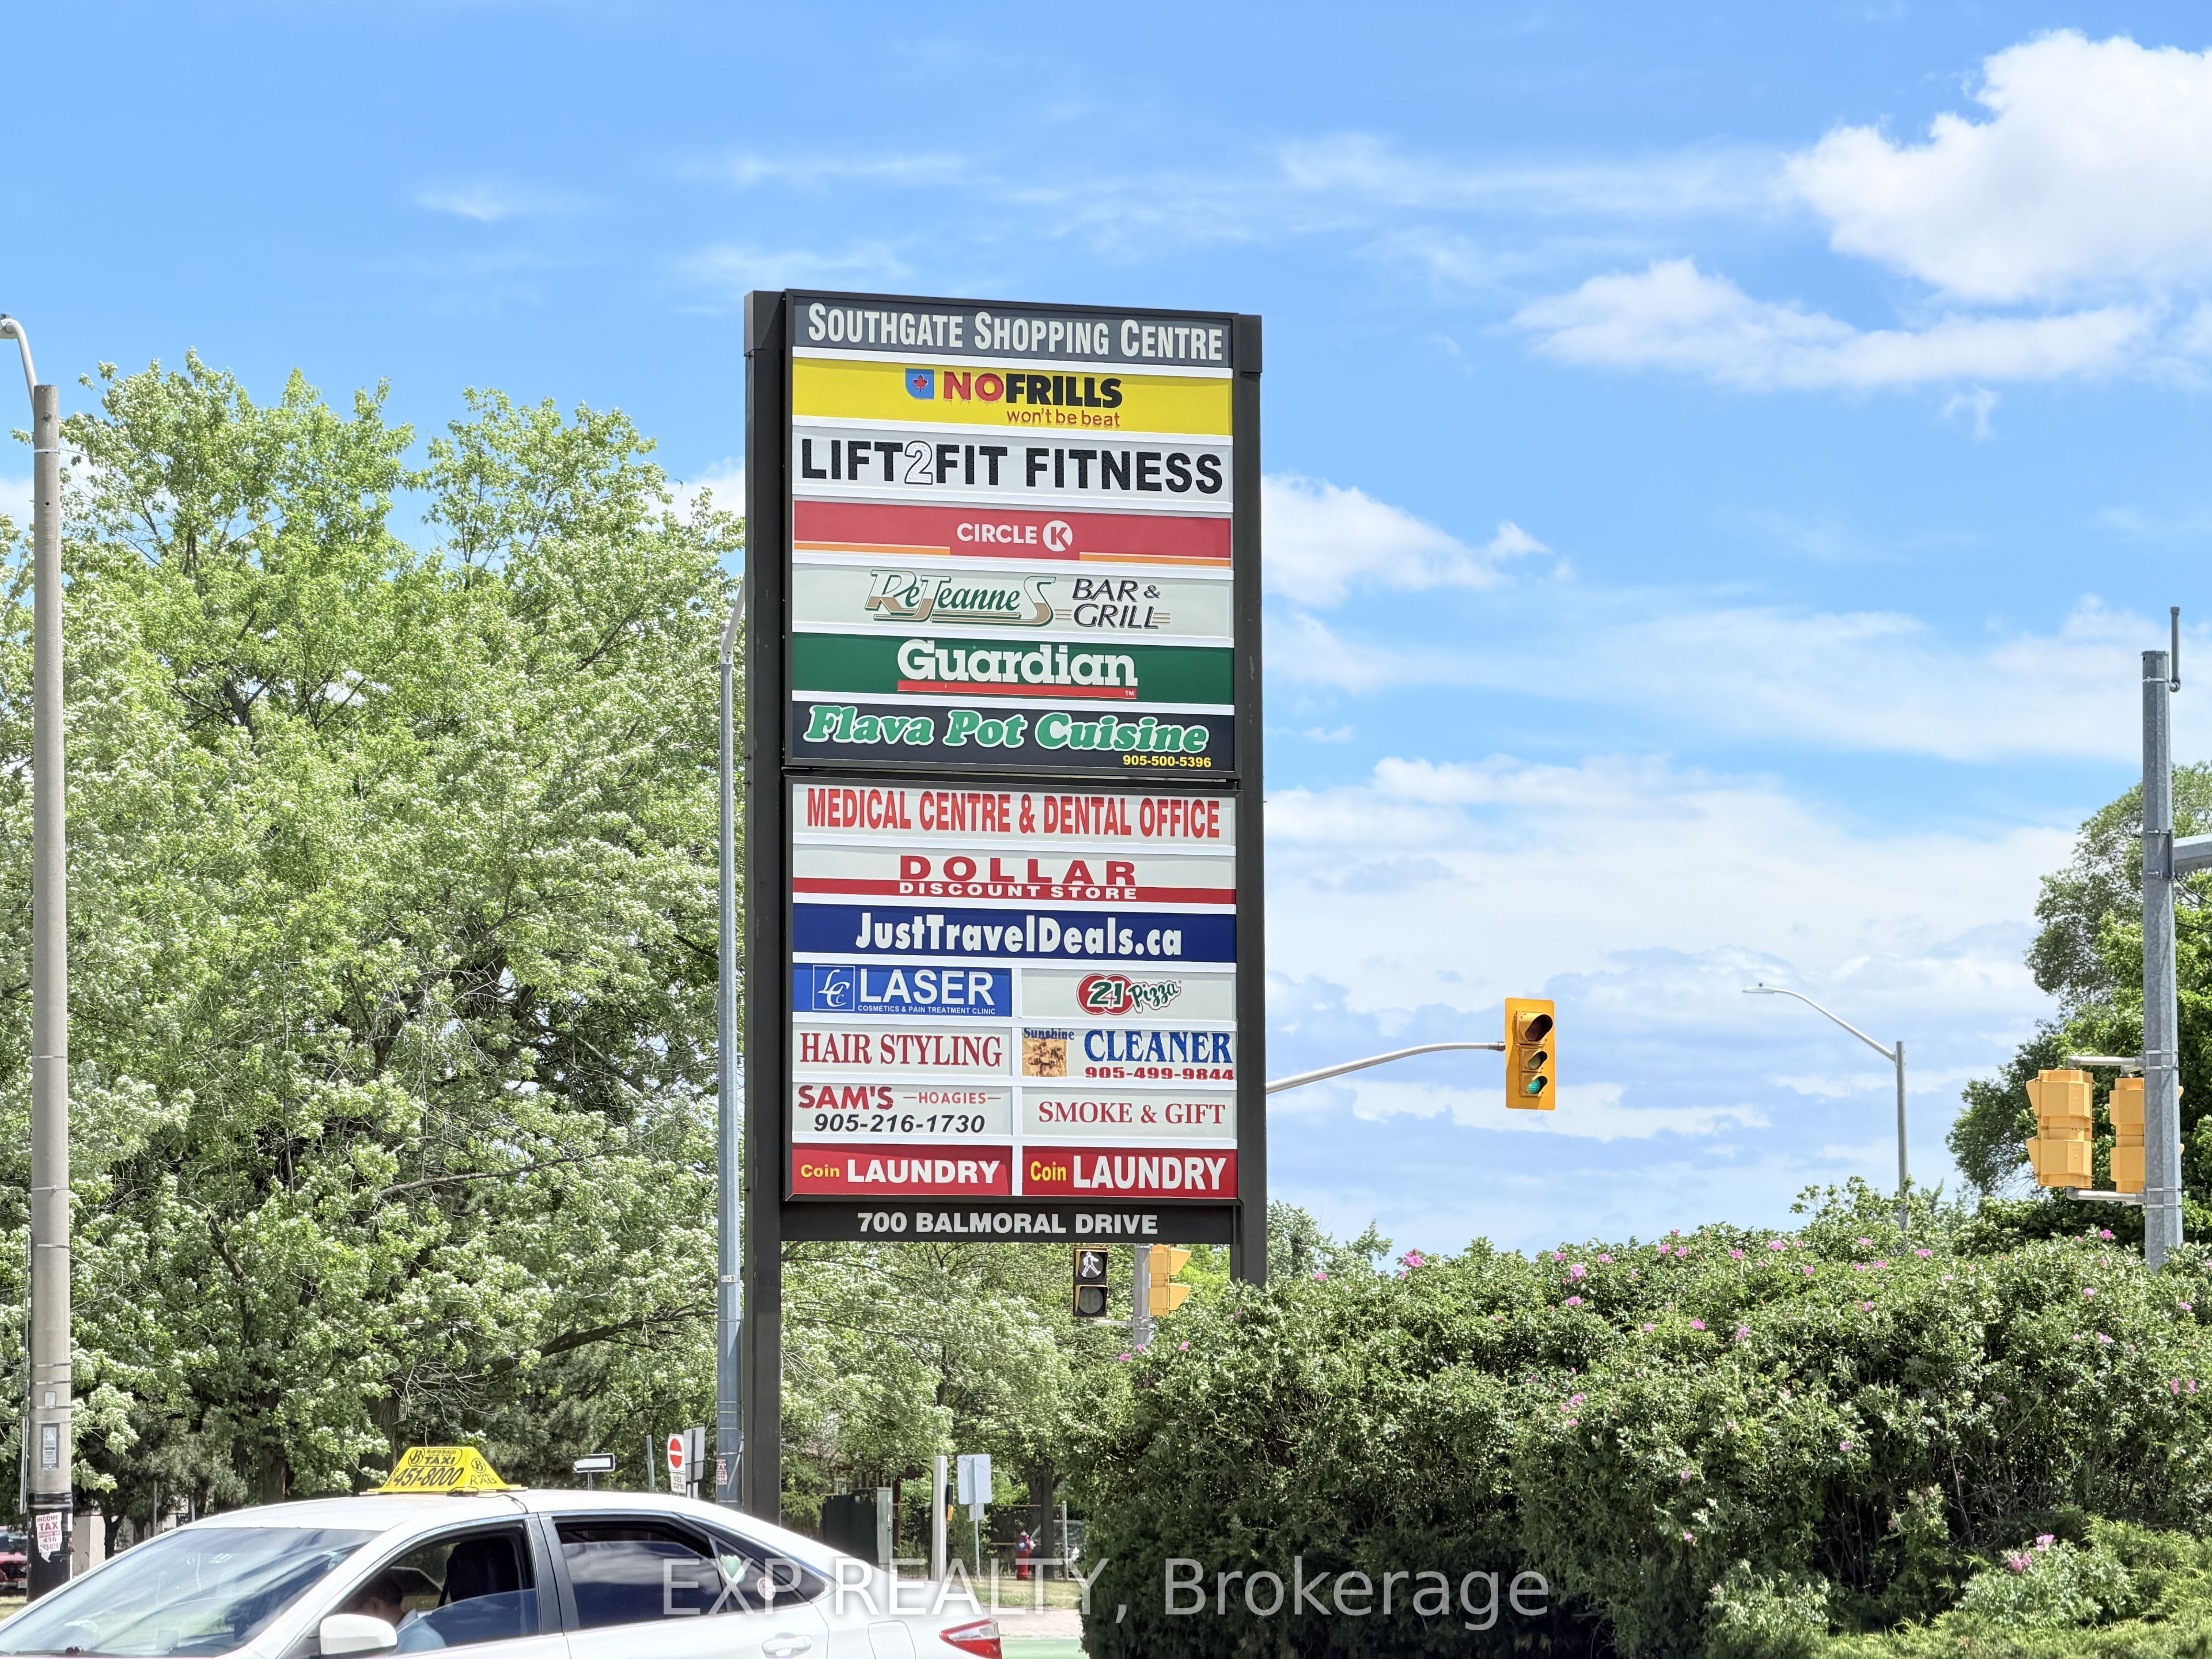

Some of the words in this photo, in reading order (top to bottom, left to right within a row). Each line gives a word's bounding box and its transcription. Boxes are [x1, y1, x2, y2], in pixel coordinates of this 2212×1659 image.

[808, 302, 963, 349] SOUTHGATE
[974, 312, 1109, 356] SHOPPING
[1120, 319, 1222, 361] CENTRE
[1007, 409, 1051, 425] won't
[1055, 410, 1077, 426] be
[1080, 411, 1120, 427] beat
[802, 438, 1007, 485] LIFT2FIT
[1026, 448, 1222, 494] FITNESS
[957, 522, 1037, 544] CIRCLE
[1072, 578, 1138, 602] BAR
[1143, 584, 1161, 599] &
[1074, 603, 1160, 630] GRILL
[897, 639, 1138, 686] Guardian
[803, 704, 935, 745] Flava
[942, 710, 1027, 748] Pot
[1036, 712, 1210, 753] Cuisine
[1123, 755, 1211, 768] 905-500-5396
[807, 787, 912, 830] MEDICAL
[920, 792, 1010, 832] CENTRE
[1018, 794, 1036, 834] &
[1043, 797, 1132, 836] DENTAL
[1139, 798, 1220, 838] OFFICE
[900, 855, 1136, 886] DOLLAR
[899, 882, 1040, 897] DISCOUNT
[1051, 886, 1137, 899] STORE
[855, 911, 1182, 956] JustTravelDeals.ca
[860, 968, 995, 1005] LASER
[1127, 980, 1179, 1008] Pizza
[1023, 1027, 1075, 1040] Sunshine
[800, 1032, 871, 1064] HAIR
[880, 1033, 1003, 1067] STYLING
[1084, 1030, 1233, 1064] CLEANER
[1085, 1067, 1234, 1080] 905-499-9844
[798, 1085, 894, 1111] SAM'S
[814, 1113, 985, 1133] 905-216-1730
[1038, 1101, 1133, 1123] SMOKE
[1140, 1104, 1156, 1124] &
[1165, 1103, 1226, 1124] GIFT
[800, 1164, 840, 1178] Coin
[847, 1159, 1000, 1183] LAUNDRY
[1030, 1161, 1066, 1182] Coin
[1073, 1154, 1227, 1191] LAUNDRY
[857, 1212, 907, 1233] 700
[916, 1212, 1067, 1234] BALMORAL
[1075, 1214, 1159, 1235] DRIVE
[425, 1457, 456, 1465] TAXI
[393, 1467, 464, 1486] 451-8000
[470, 1477, 497, 1485] KAB
[39, 1522, 58, 1532] TAX
